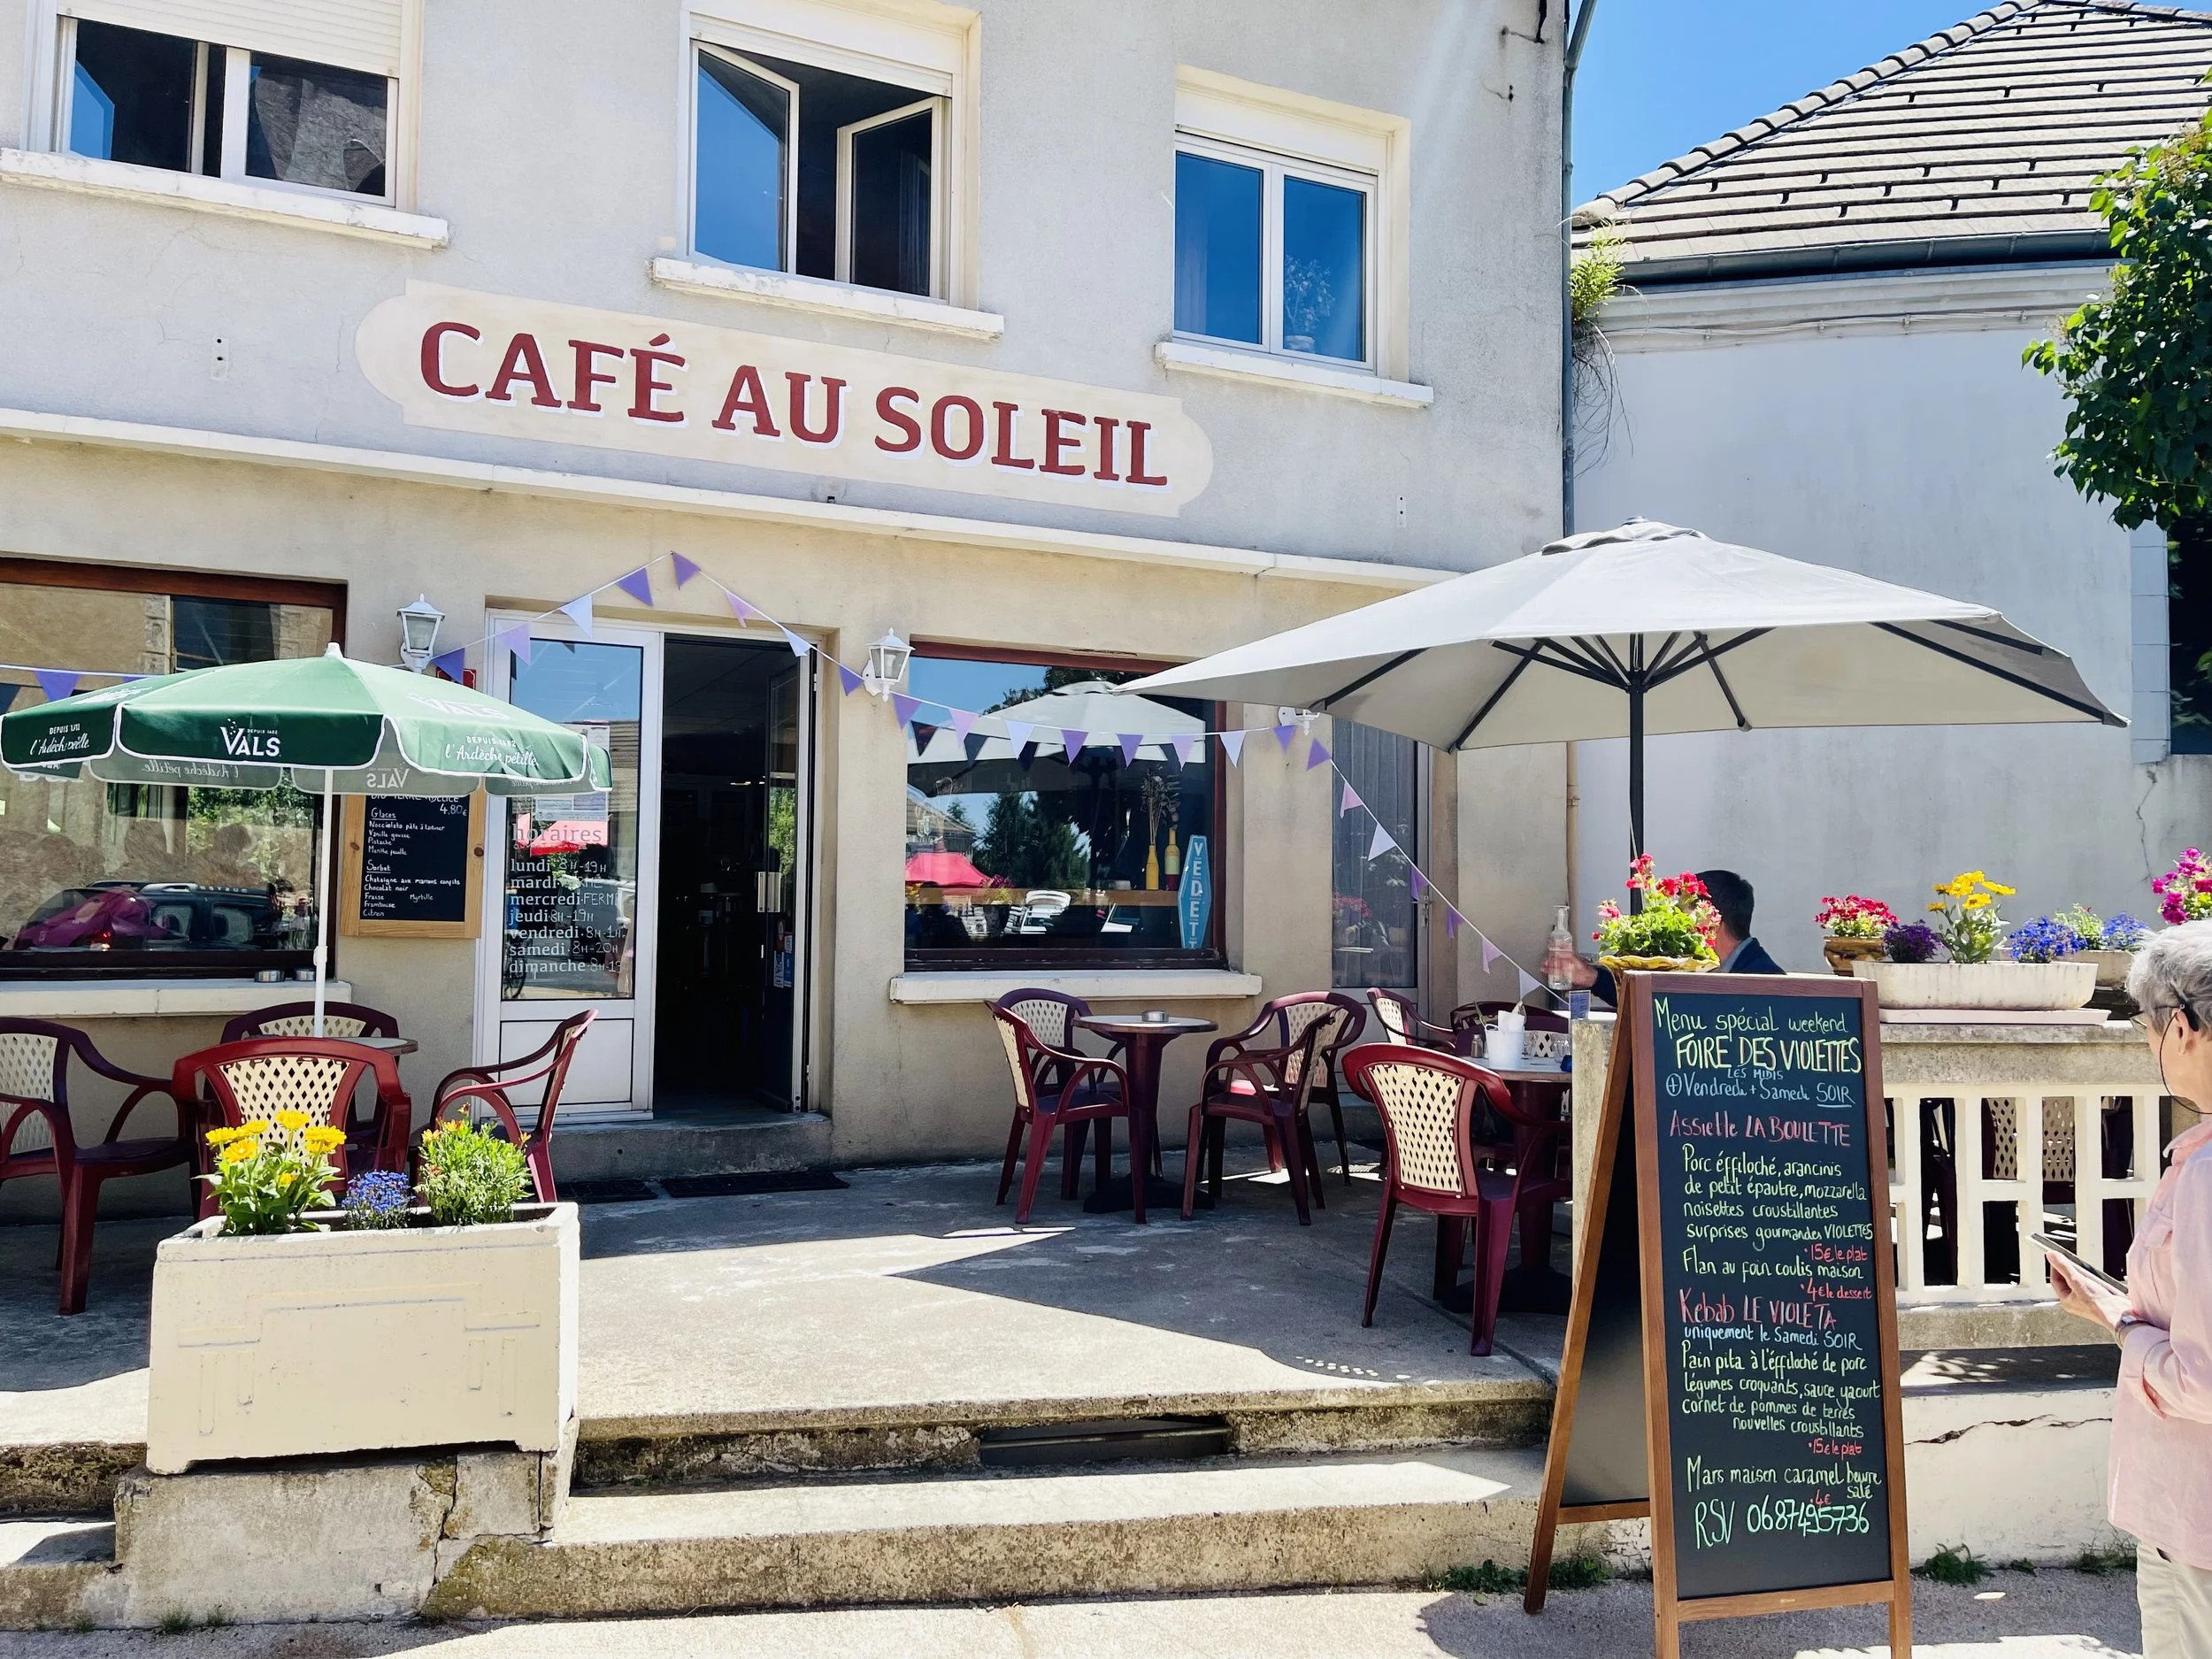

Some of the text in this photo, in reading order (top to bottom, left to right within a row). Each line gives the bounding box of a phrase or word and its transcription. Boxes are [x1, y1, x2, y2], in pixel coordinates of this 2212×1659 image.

[420, 321, 1170, 488] CAFÉ AU SOLEIL
[50, 724, 69, 734] DEPUIS
[220, 726, 281, 757] VALS
[465, 735, 495, 746] DEPUIS
[445, 743, 503, 763] l'Ardèche
[371, 807, 396, 818] Glaces
[368, 837, 392, 846] Pistache
[511, 823, 602, 841] horaires
[368, 846, 407, 856] Menthe feuille
[366, 859, 391, 872] Sorbet
[511, 858, 550, 872] lundi
[511, 876, 557, 889] mardi
[410, 894, 434, 902] Myrtille
[510, 893, 618, 906] mercredi FERM
[508, 910, 549, 926] jeudi
[510, 926, 579, 938] vendredi
[510, 942, 565, 956] samedi
[509, 959, 585, 973] dimanche
[1655, 996, 1848, 1042] Menu spécial weekend
[1676, 1033, 1862, 1073] FOIRE DES VIOLETTES
[1727, 1067, 1784, 1080] LES MIDIS
[1683, 1071, 1747, 1096] Vendredi
[1760, 1078, 1810, 1102] Samedi
[1816, 1083, 1855, 1104] SOIR
[1745, 1115, 1766, 1139] LA
[1770, 1117, 1851, 1147] BOULETTE
[1682, 1143, 1712, 1173] Porc
[1784, 1160, 1842, 1177] arancinis
[1685, 1175, 1702, 1194] de
[1709, 1177, 1742, 1199] petit
[1805, 1182, 1867, 1202] mozzarella
[1684, 1201, 1839, 1219] noisettes croustillantes
[1686, 1223, 1873, 1251] surprises gourmandes VIOLETTES
[1682, 1244, 1864, 1283] Flan au foin coulis maison
[1833, 1244, 1845, 1260] le
[1846, 1245, 1868, 1265] plat
[1836, 1286, 1872, 1300] dessert
[1679, 1286, 1735, 1325] Kebab
[1743, 1295, 1763, 1324] LE
[1684, 1325, 1863, 1351] uniquement le Samedi SOIR
[1681, 1340, 1711, 1370] Pain
[1715, 1348, 1745, 1375] pita
[1750, 1349, 1758, 1370] à
[1823, 1355, 1836, 1372] de
[1840, 1356, 1867, 1377] porc
[1684, 1371, 1733, 1400] légumes
[1804, 1381, 1835, 1399] sauce
[1836, 1379, 1881, 1410] yaourt
[1681, 1398, 1856, 1420] cornet de pommes de terres
[1732, 1415, 1863, 1439] nouvelles croustillants
[1840, 1439, 1863, 1460] plat
[1687, 1455, 1883, 1493] Mars maison caramel beurre
[1847, 1485, 1873, 1500] salé
[1694, 1498, 1736, 1549] RSV
